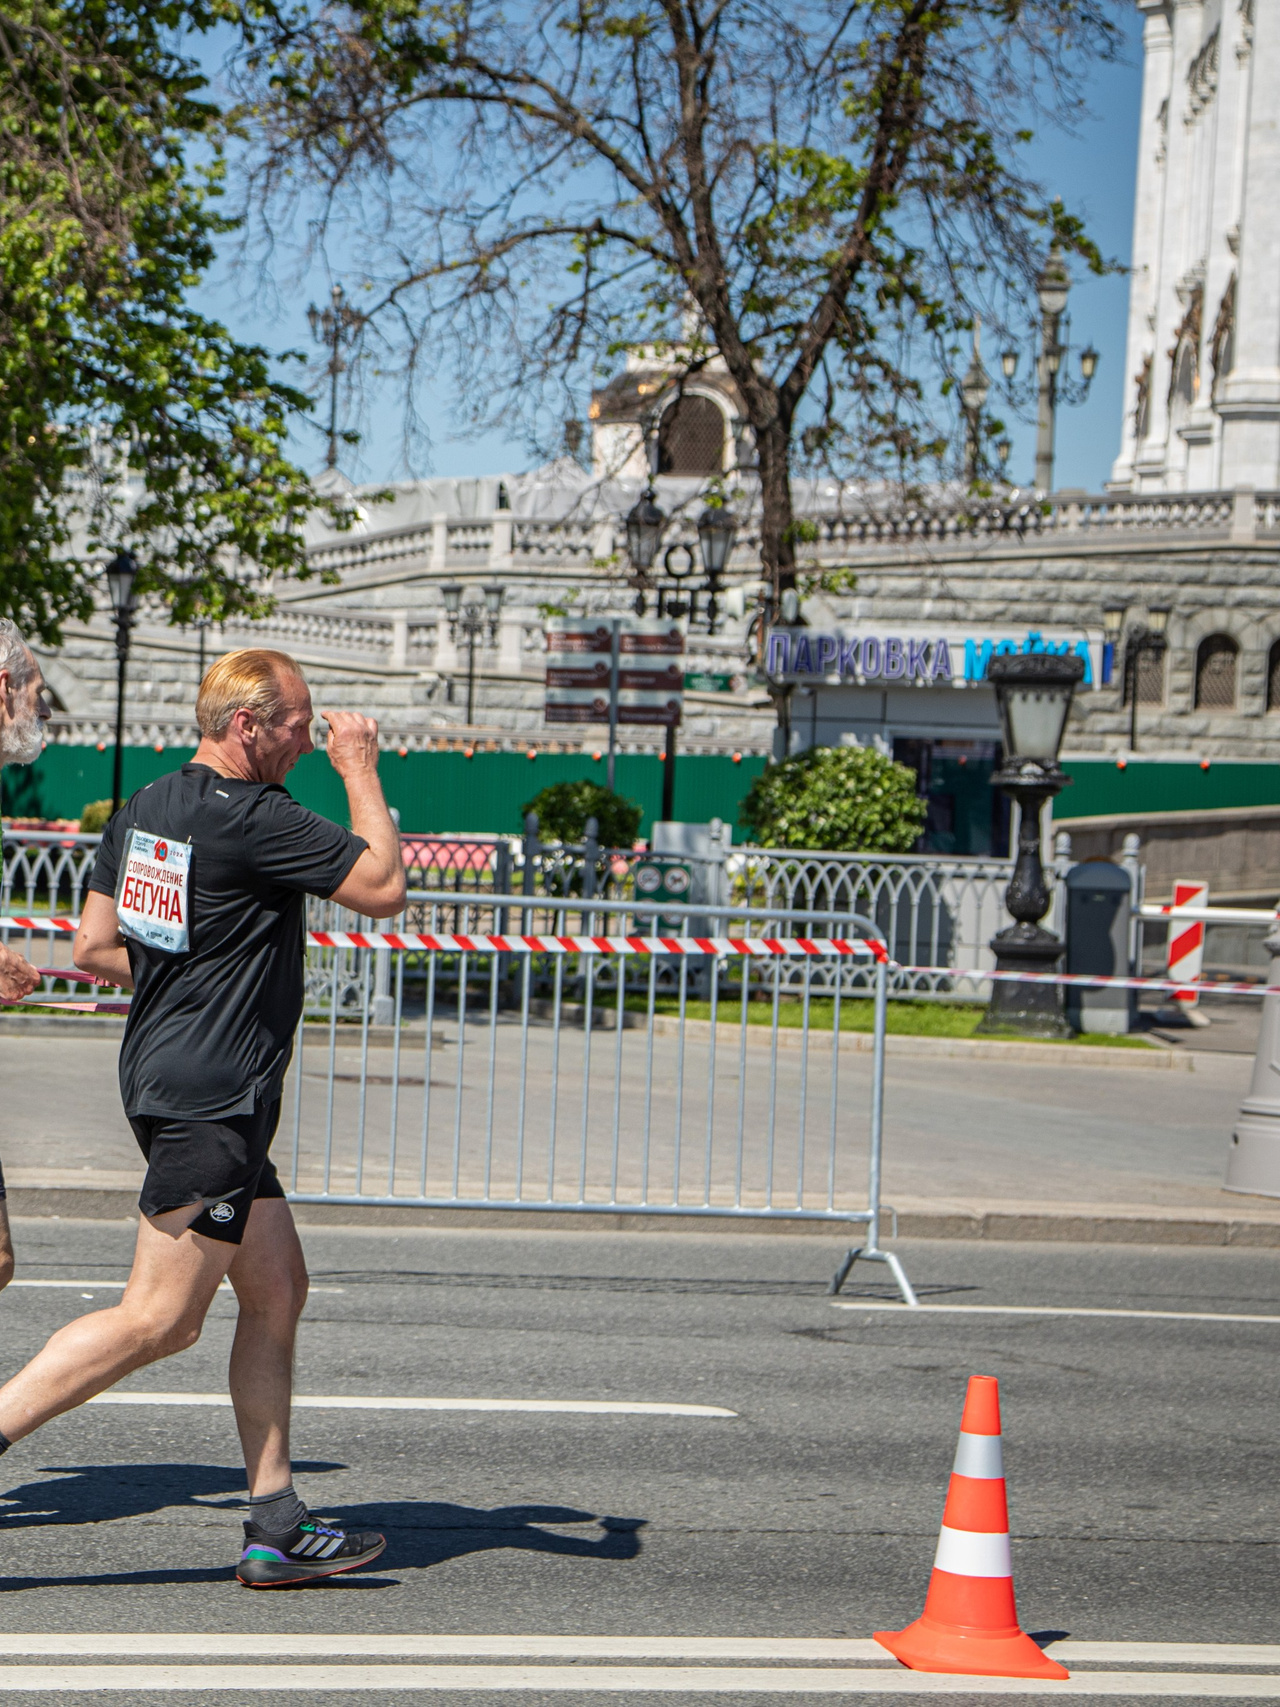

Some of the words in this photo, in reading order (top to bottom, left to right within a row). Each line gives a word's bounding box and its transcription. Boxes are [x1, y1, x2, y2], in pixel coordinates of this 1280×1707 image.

[769, 633, 954, 681] ПАРКОВКА
[128, 860, 183, 886] СОПРОВОЖДЕНИЕ
[122, 876, 183, 924] БЕГУНА
